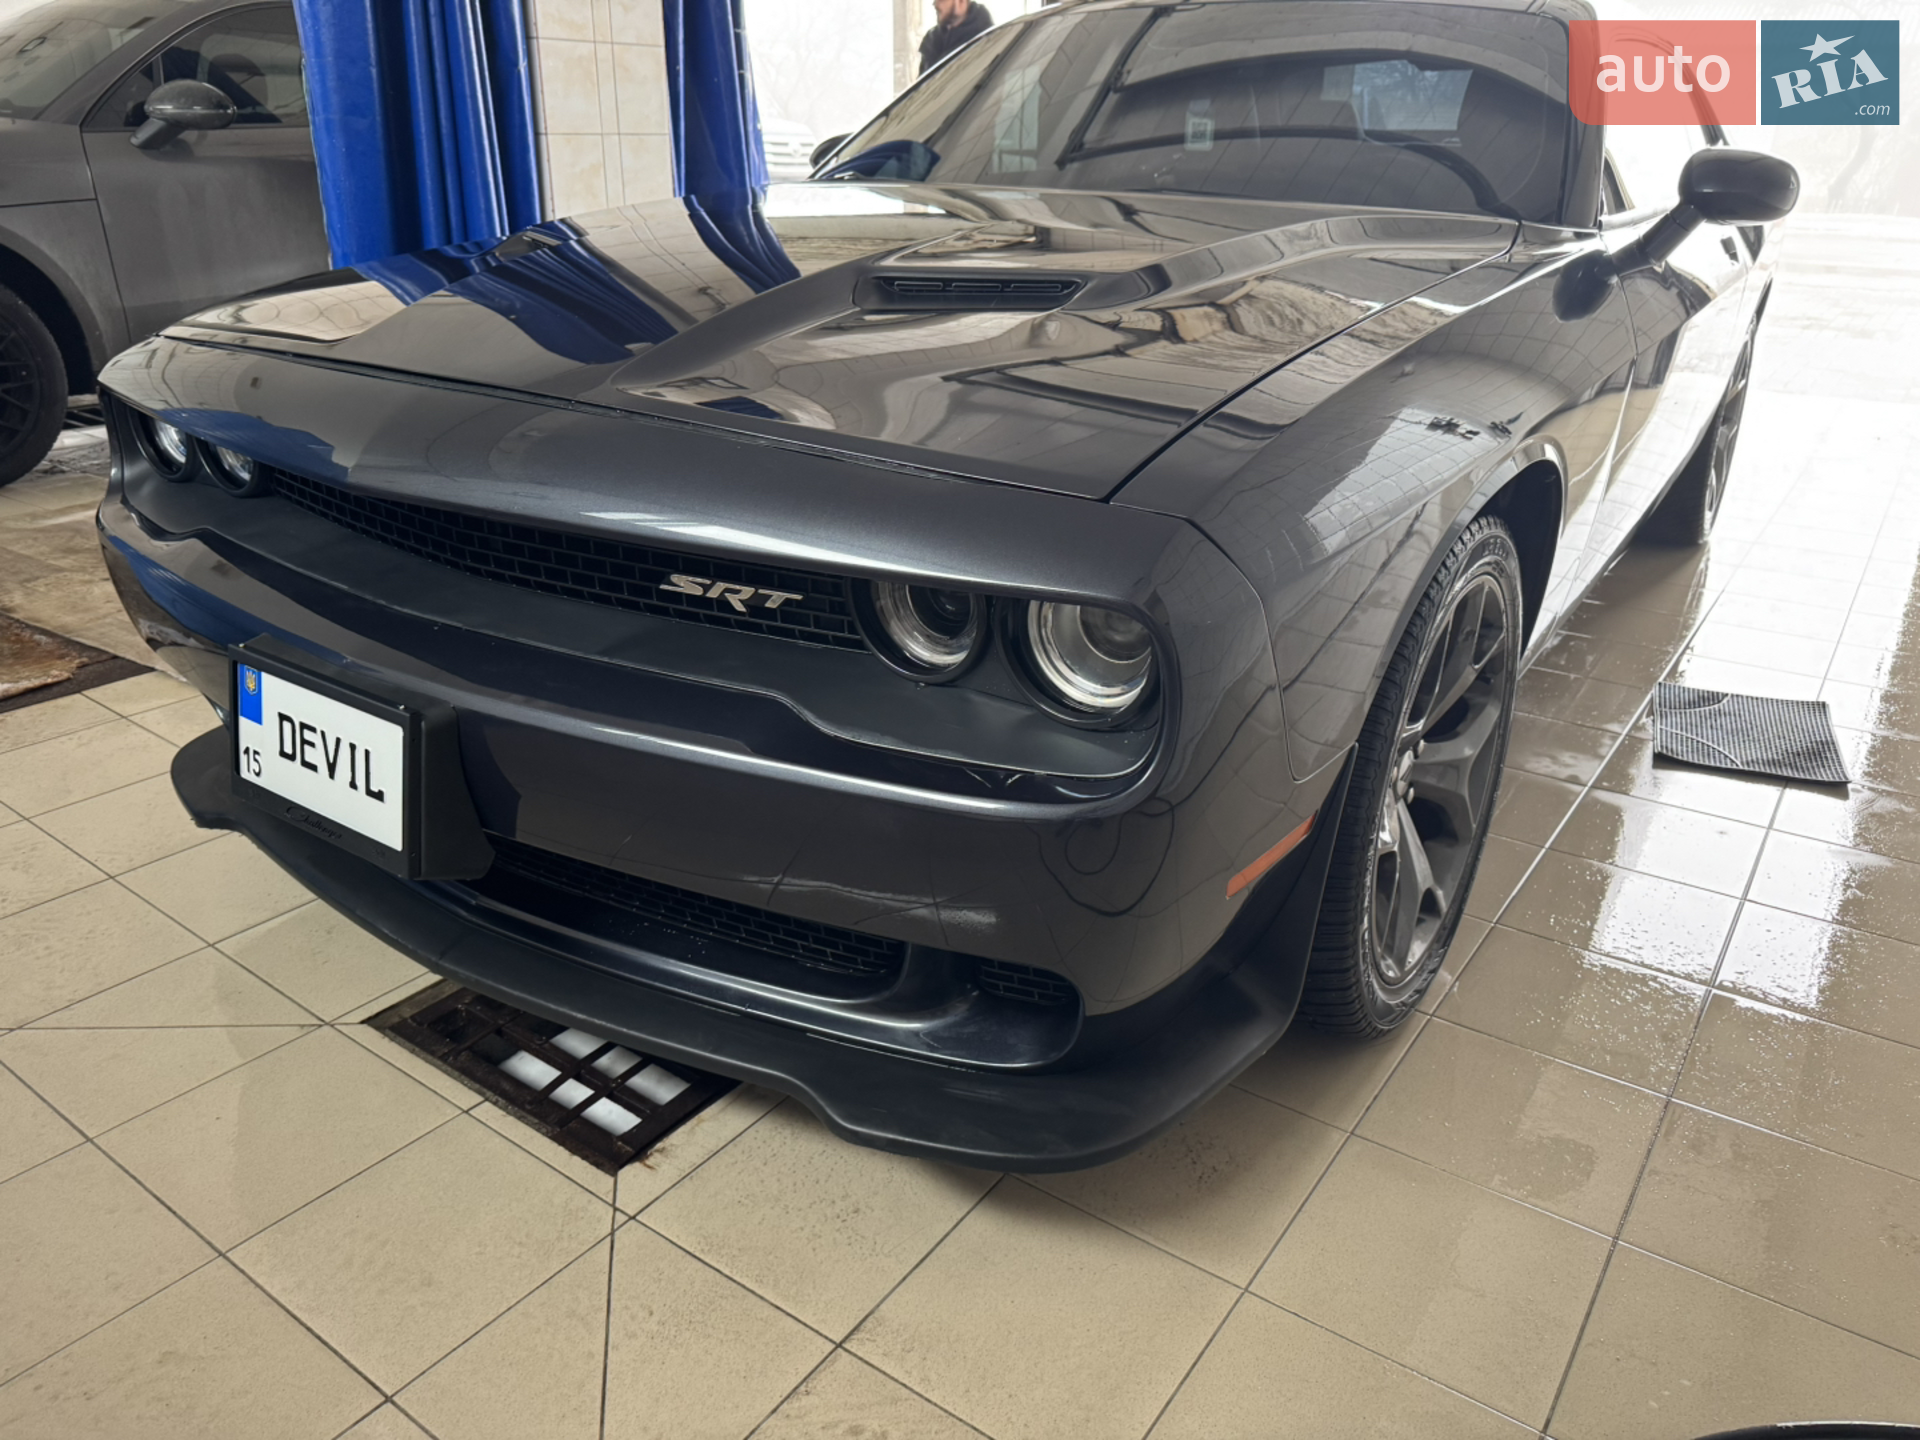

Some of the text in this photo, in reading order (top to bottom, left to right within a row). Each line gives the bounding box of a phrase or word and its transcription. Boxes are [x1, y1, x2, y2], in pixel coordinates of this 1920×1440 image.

[659, 573, 804, 613] SRT
[243, 746, 262, 778] 15
[277, 711, 385, 803] DEVIL
